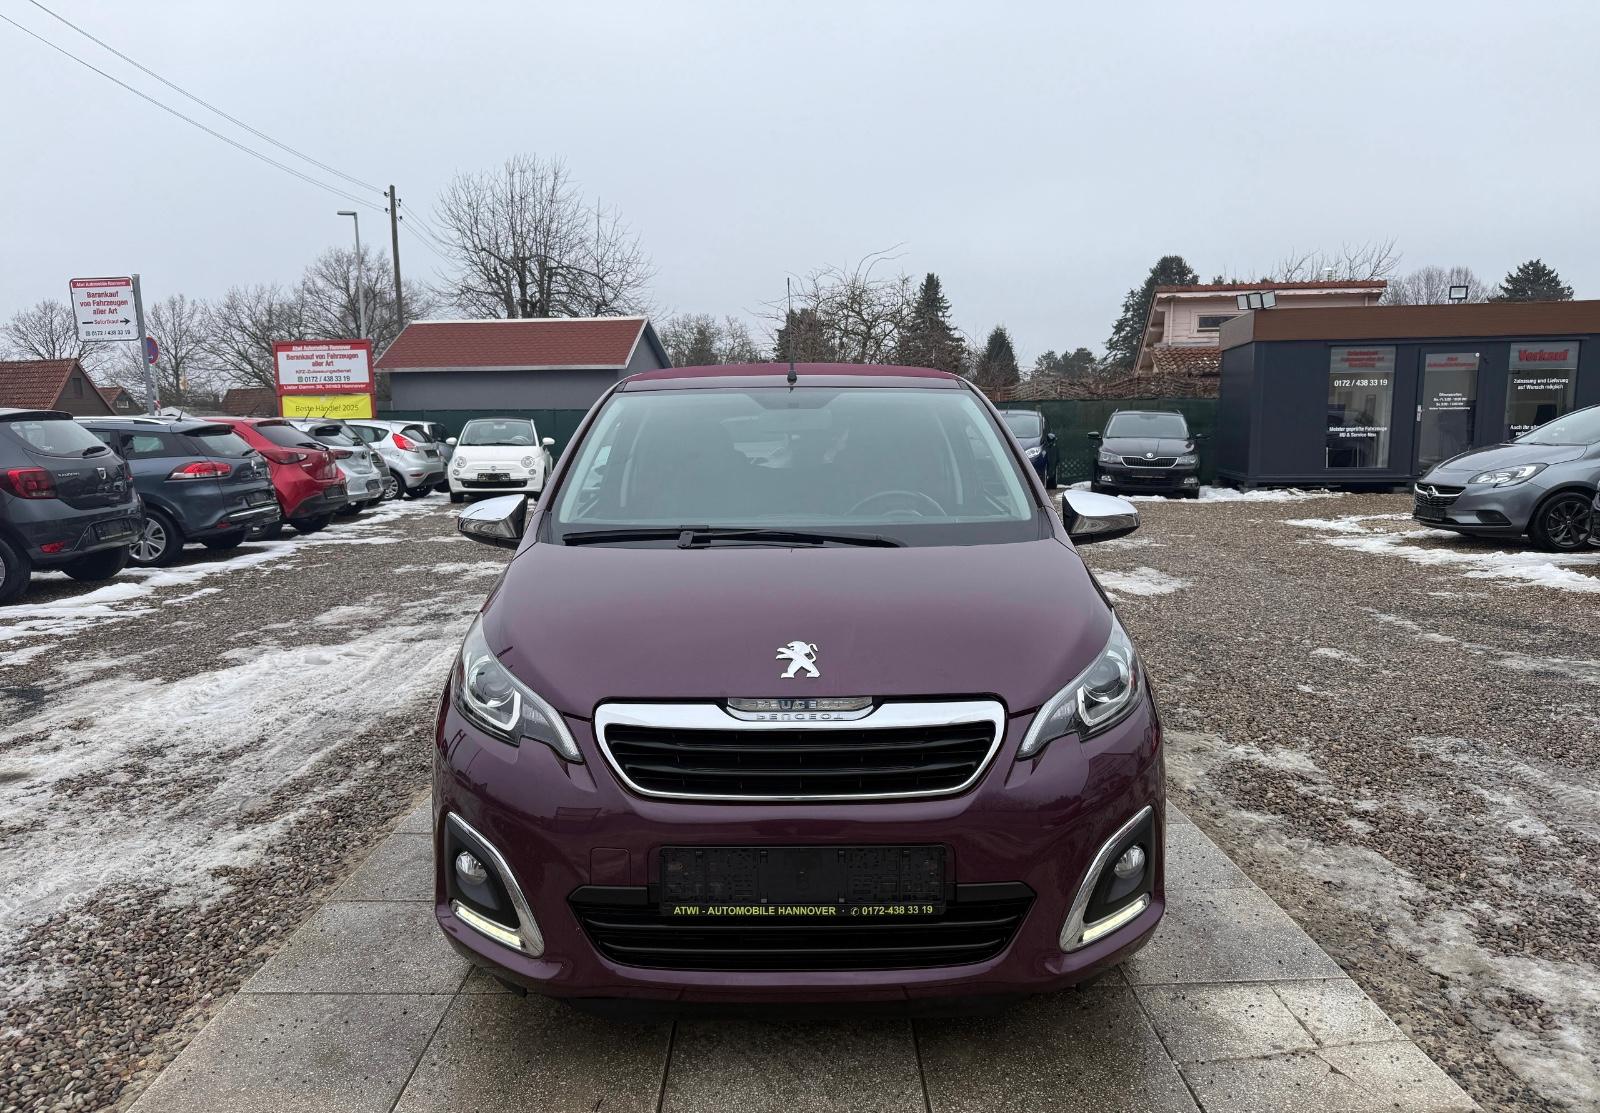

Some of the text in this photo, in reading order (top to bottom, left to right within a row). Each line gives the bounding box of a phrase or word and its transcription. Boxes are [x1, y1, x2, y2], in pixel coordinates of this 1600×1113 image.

[1519, 349, 1569, 361] Verkauf
[674, 906, 699, 914] ATWI
[708, 906, 775, 915] AUTOMOBILE
[778, 906, 836, 915] HANNOVER
[862, 906, 905, 914] 0172-438
[907, 906, 919, 914] 33
